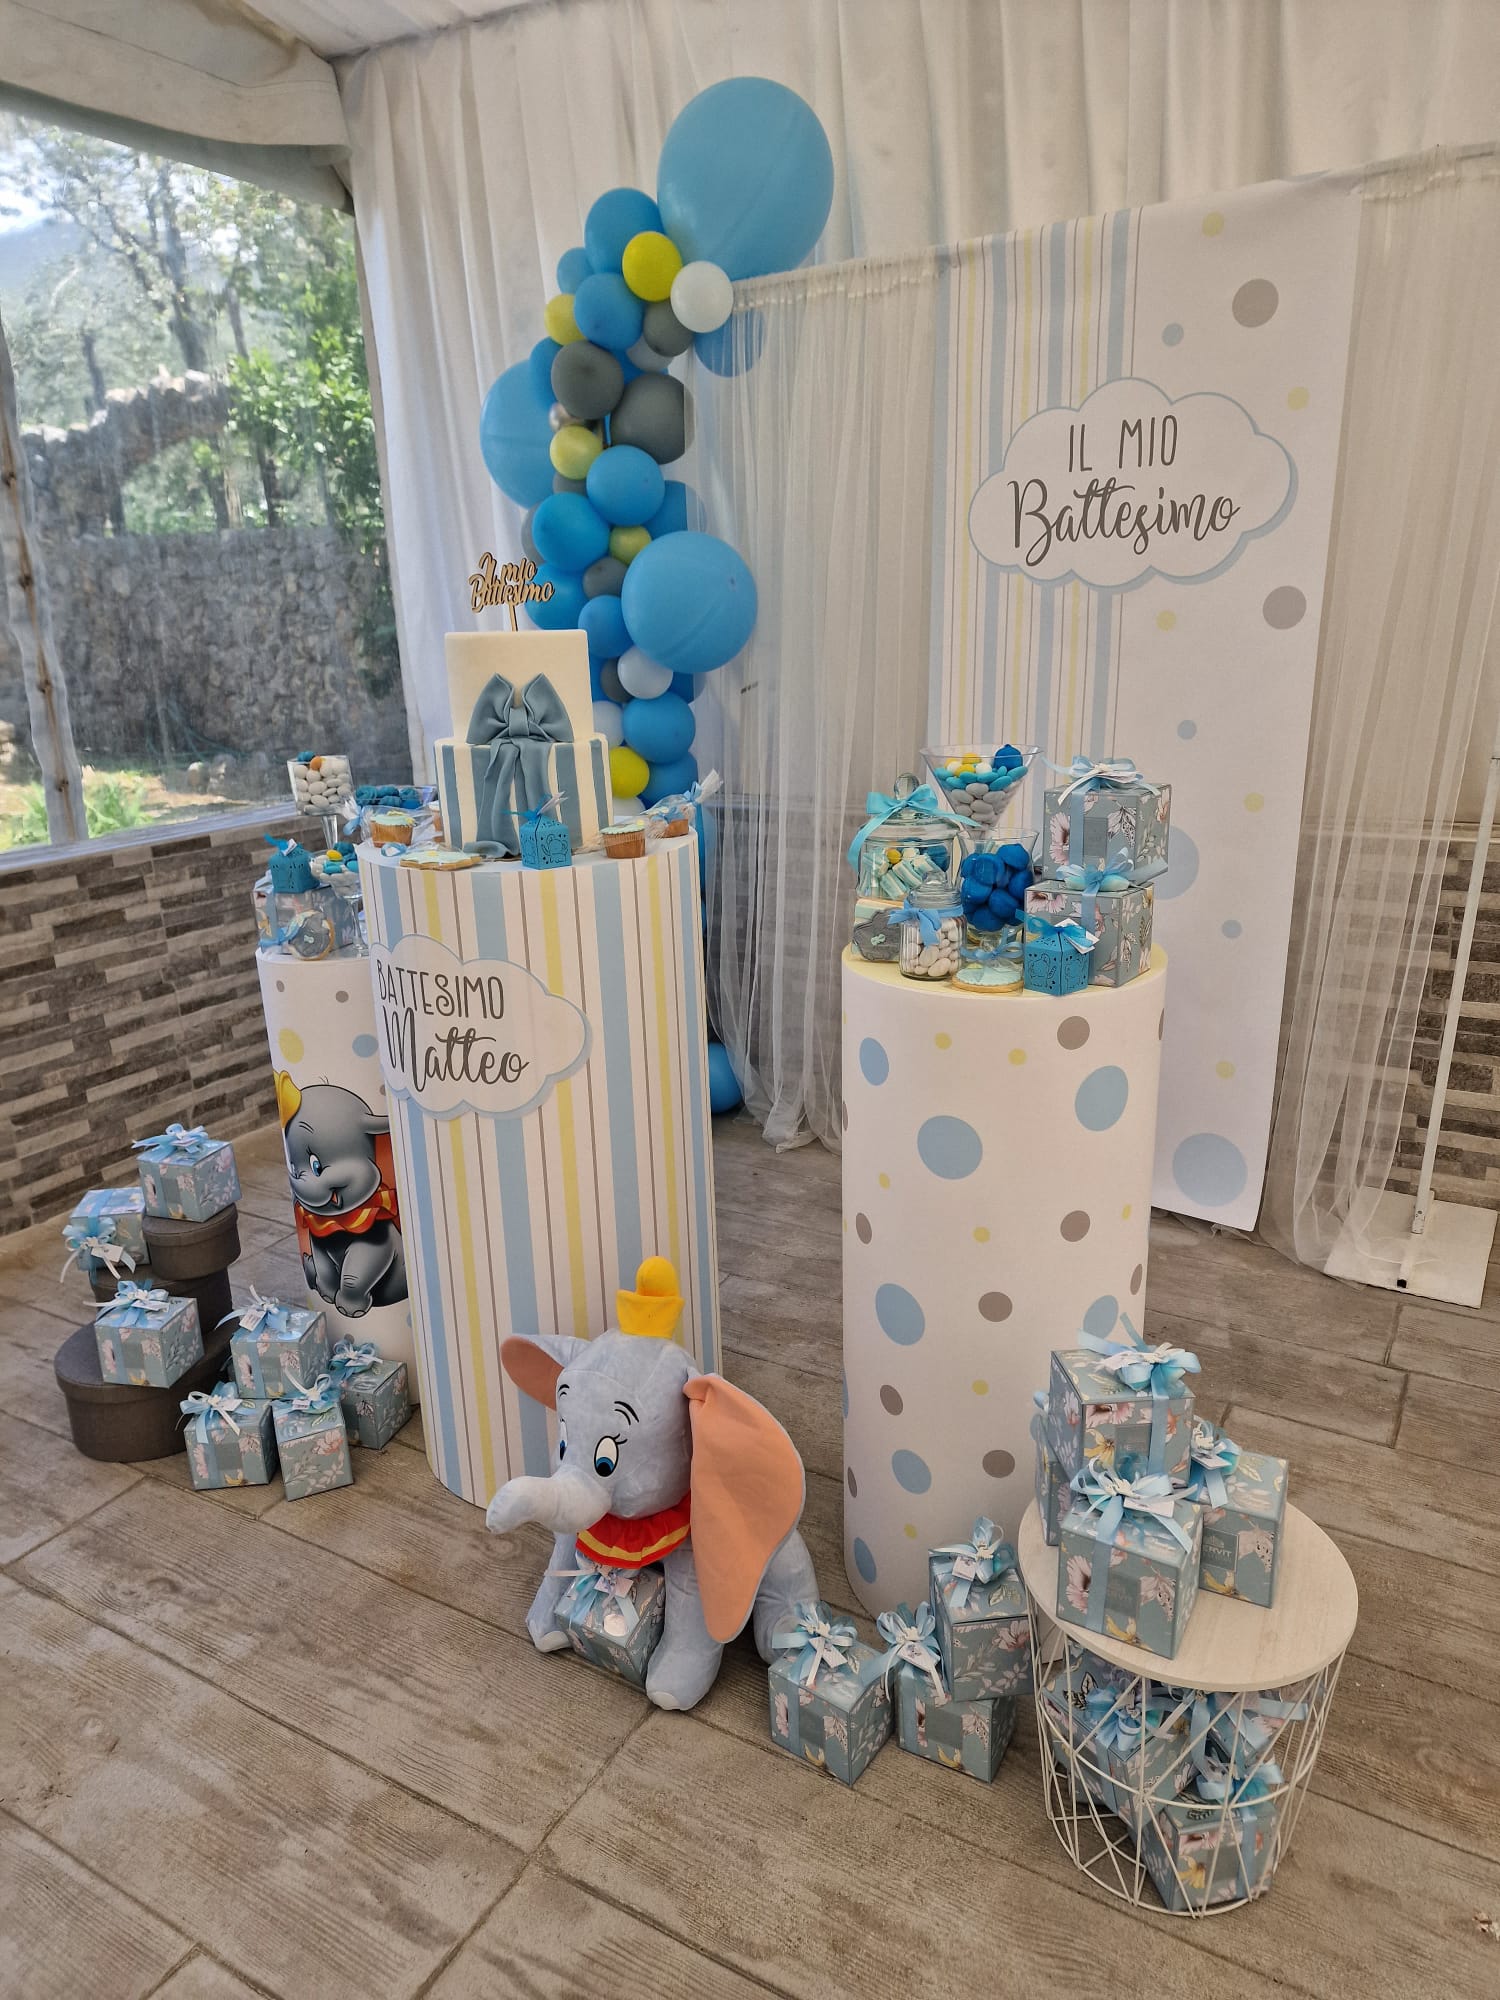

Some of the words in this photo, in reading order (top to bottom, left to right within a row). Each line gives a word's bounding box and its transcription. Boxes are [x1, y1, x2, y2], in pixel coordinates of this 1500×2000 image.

[1068, 423, 1093, 473] IL
[1118, 414, 1178, 470] MIO
[1007, 477, 1241, 567] Battesimo
[376, 959, 505, 1020] BATTESIMO
[382, 1004, 530, 1093] Matteo
